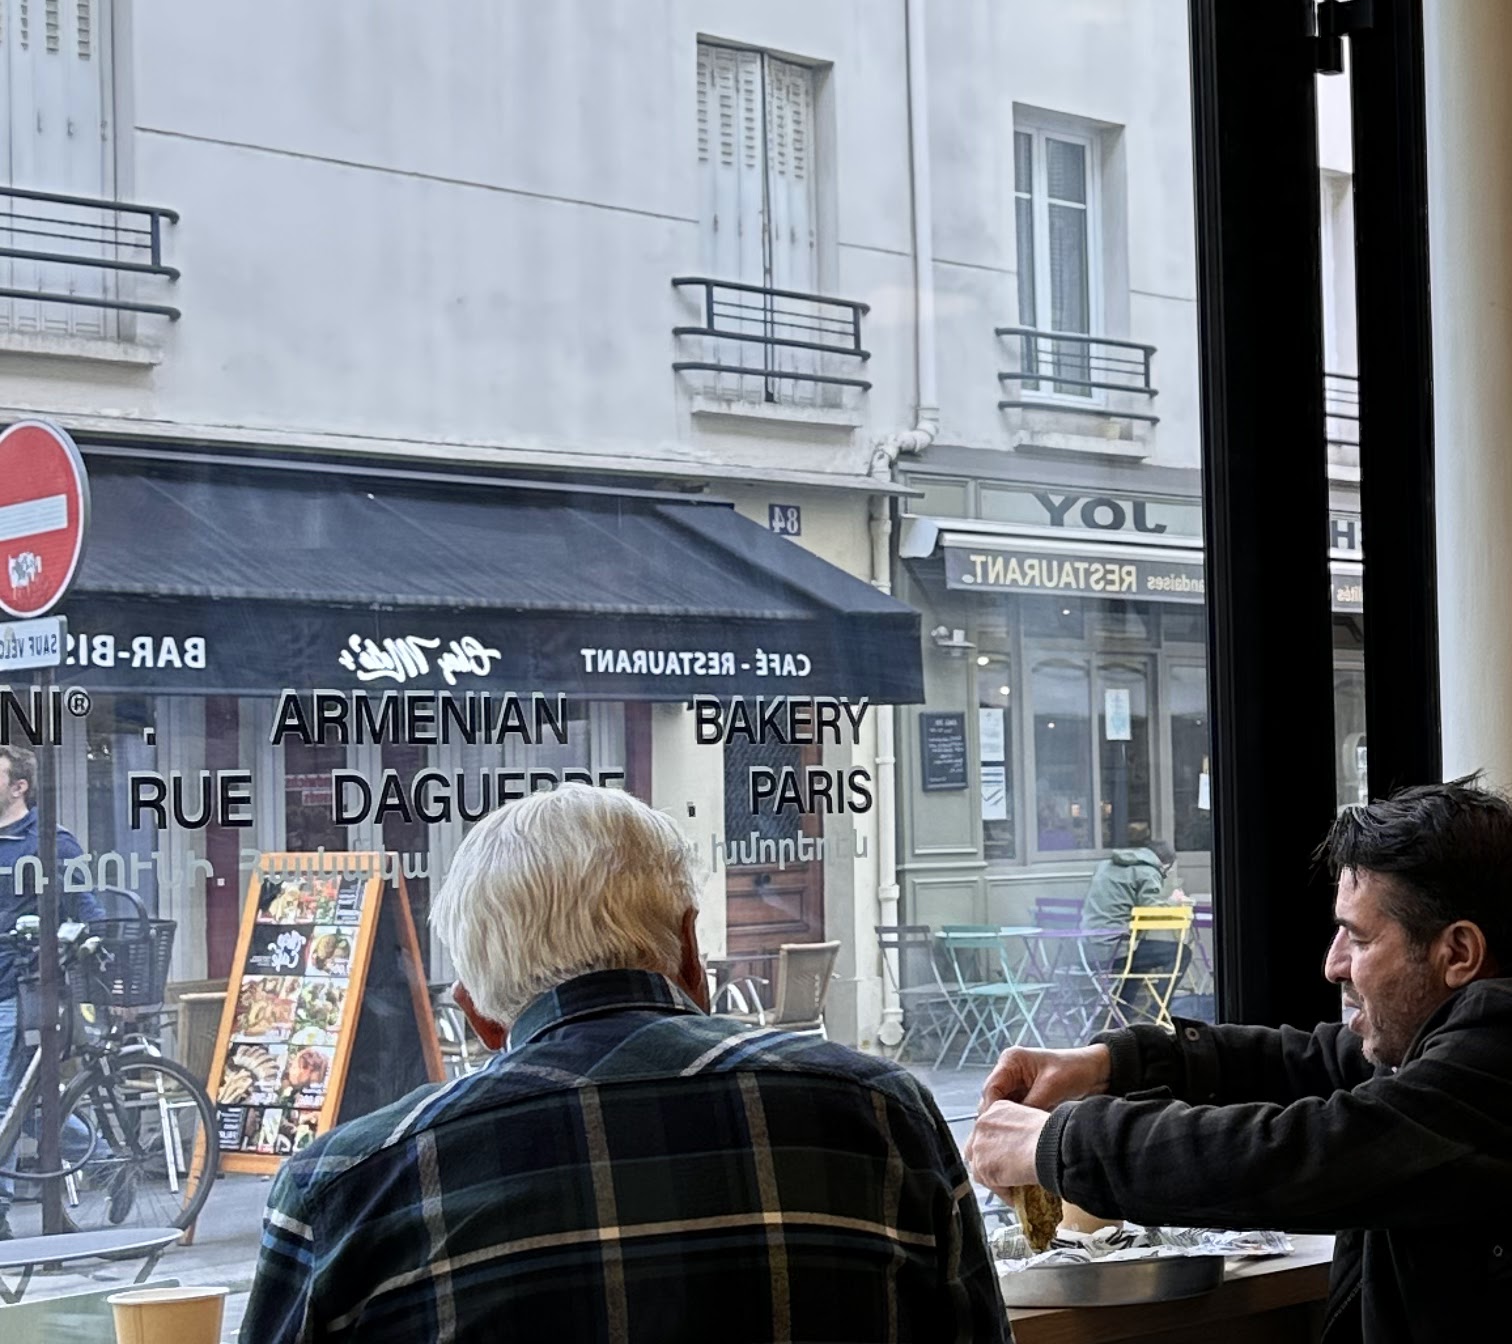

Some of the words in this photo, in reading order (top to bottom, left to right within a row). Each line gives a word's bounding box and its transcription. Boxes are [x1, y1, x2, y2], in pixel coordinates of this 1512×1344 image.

[271, 688, 569, 746] ARMENIAN
[693, 695, 869, 746] BAKERY
[129, 770, 254, 830] RUE
[750, 766, 874, 817] PARIS
